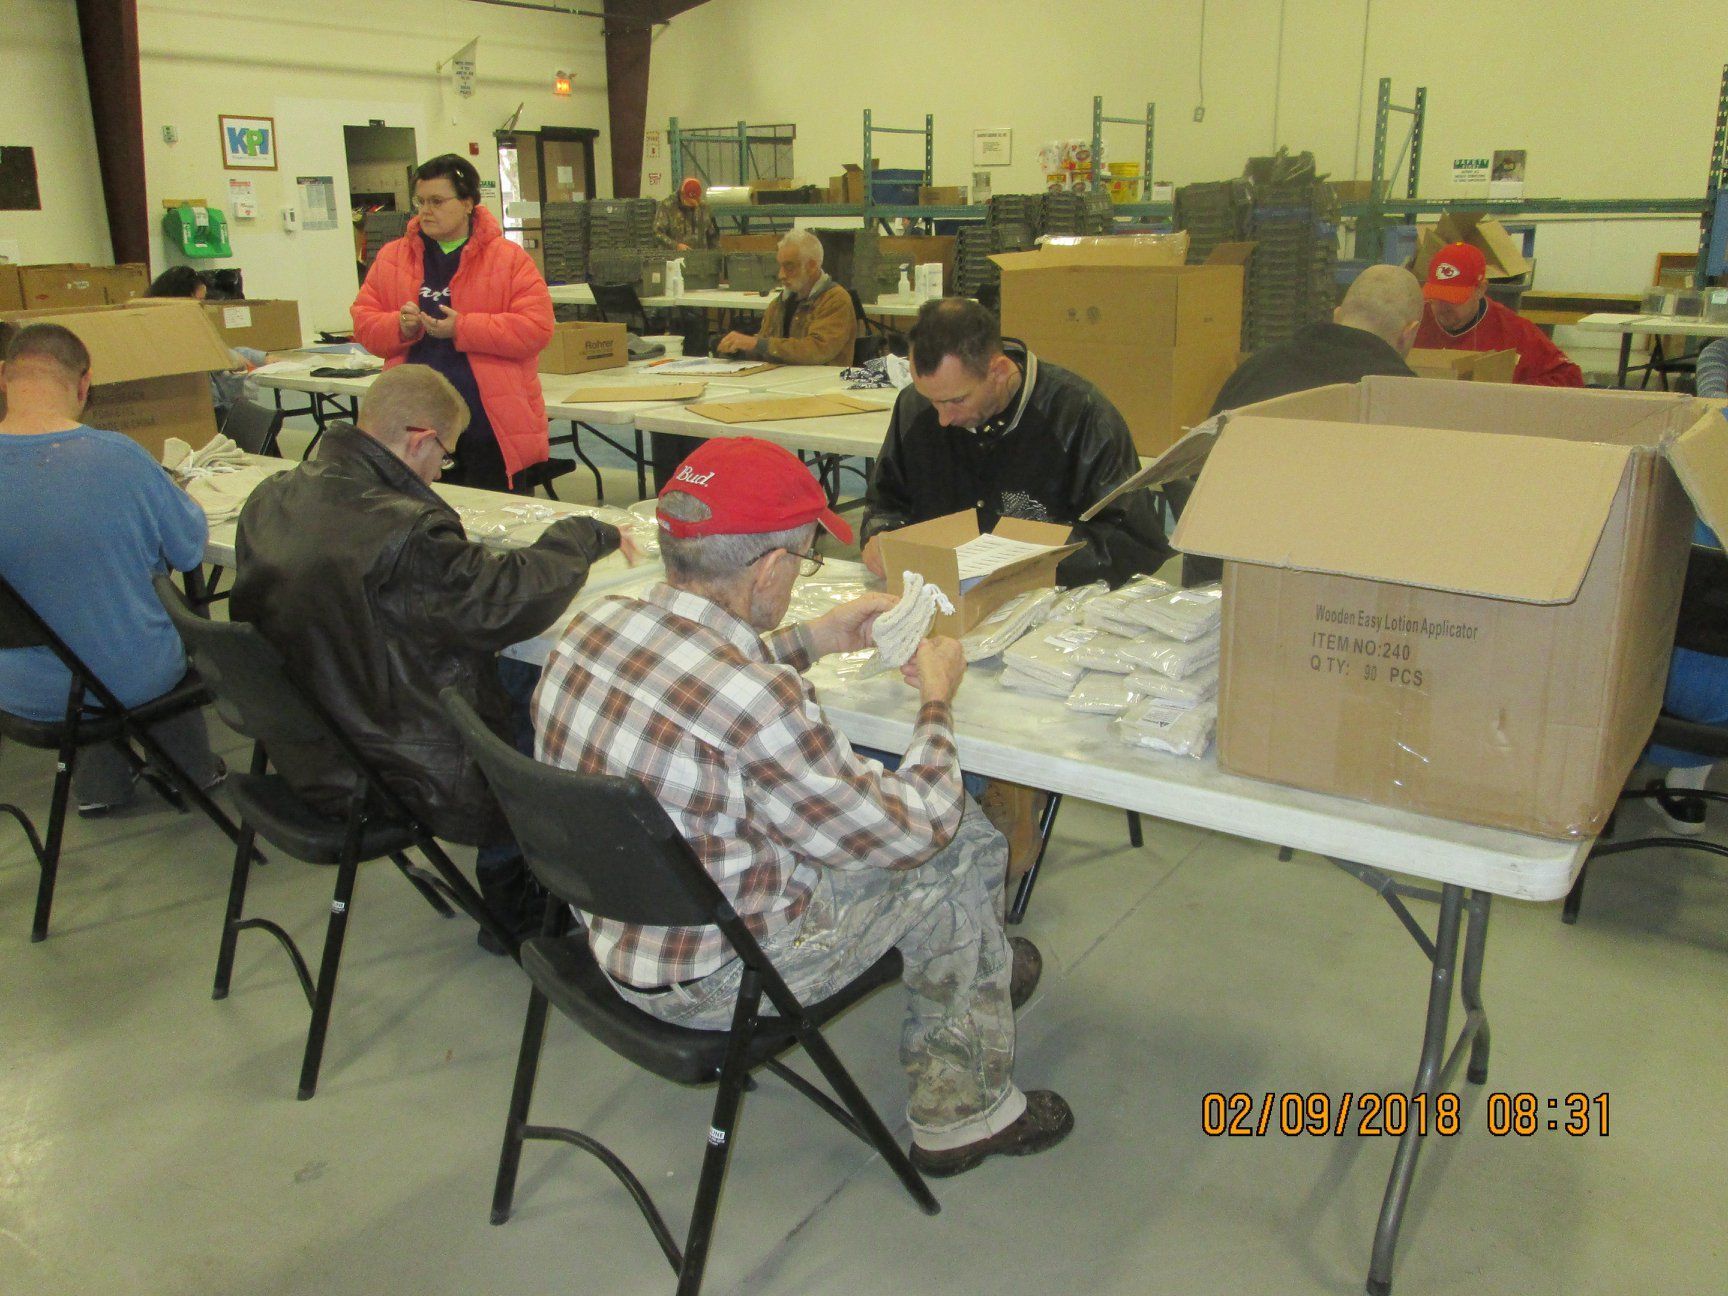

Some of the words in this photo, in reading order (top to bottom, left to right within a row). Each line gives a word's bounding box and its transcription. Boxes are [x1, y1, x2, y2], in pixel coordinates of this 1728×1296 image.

[226, 126, 269, 156] KPI
[585, 340, 614, 351] Rohrer
[676, 465, 716, 487] Bud
[1316, 604, 1355, 626] Wooden
[1357, 610, 1383, 632] Easy
[1384, 613, 1419, 633] Lotion
[1420, 617, 1478, 640] Applicator
[1312, 631, 1349, 651] ITEM
[1353, 637, 1411, 661] NO:240
[1364, 664, 1377, 681] 90
[1389, 666, 1424, 687] PCS
